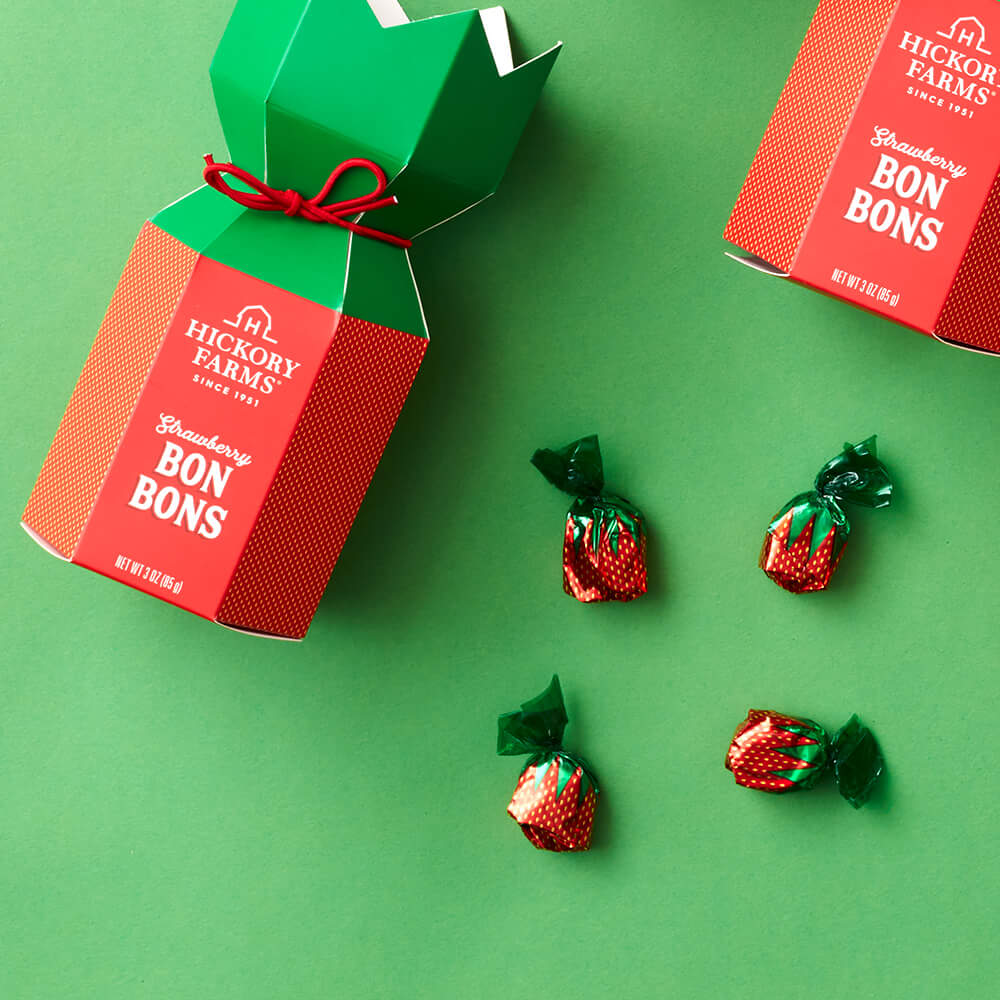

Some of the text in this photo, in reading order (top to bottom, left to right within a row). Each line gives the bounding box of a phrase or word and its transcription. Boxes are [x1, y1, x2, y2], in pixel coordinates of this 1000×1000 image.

[907, 86, 974, 119] SINCE 1951
[870, 125, 967, 179] Strawberry
[870, 153, 949, 210] BON
[843, 187, 944, 251] BONS
[831, 268, 848, 284] NET
[847, 274, 861, 289] WT
[859, 280, 867, 292] 3
[866, 282, 879, 297] OZ
[876, 287, 892, 302] (85
[185, 319, 301, 379] HICKORY
[193, 374, 259, 407] SINCE 1951
[155, 413, 252, 467] Strawberry
[155, 440, 234, 498] BON
[128, 474, 228, 539] BONS
[115, 555, 132, 571] NET
[130, 561, 144, 576] WT
[143, 567, 151, 579] 3
[149, 569, 162, 584] OZ
[160, 574, 175, 589] (85
